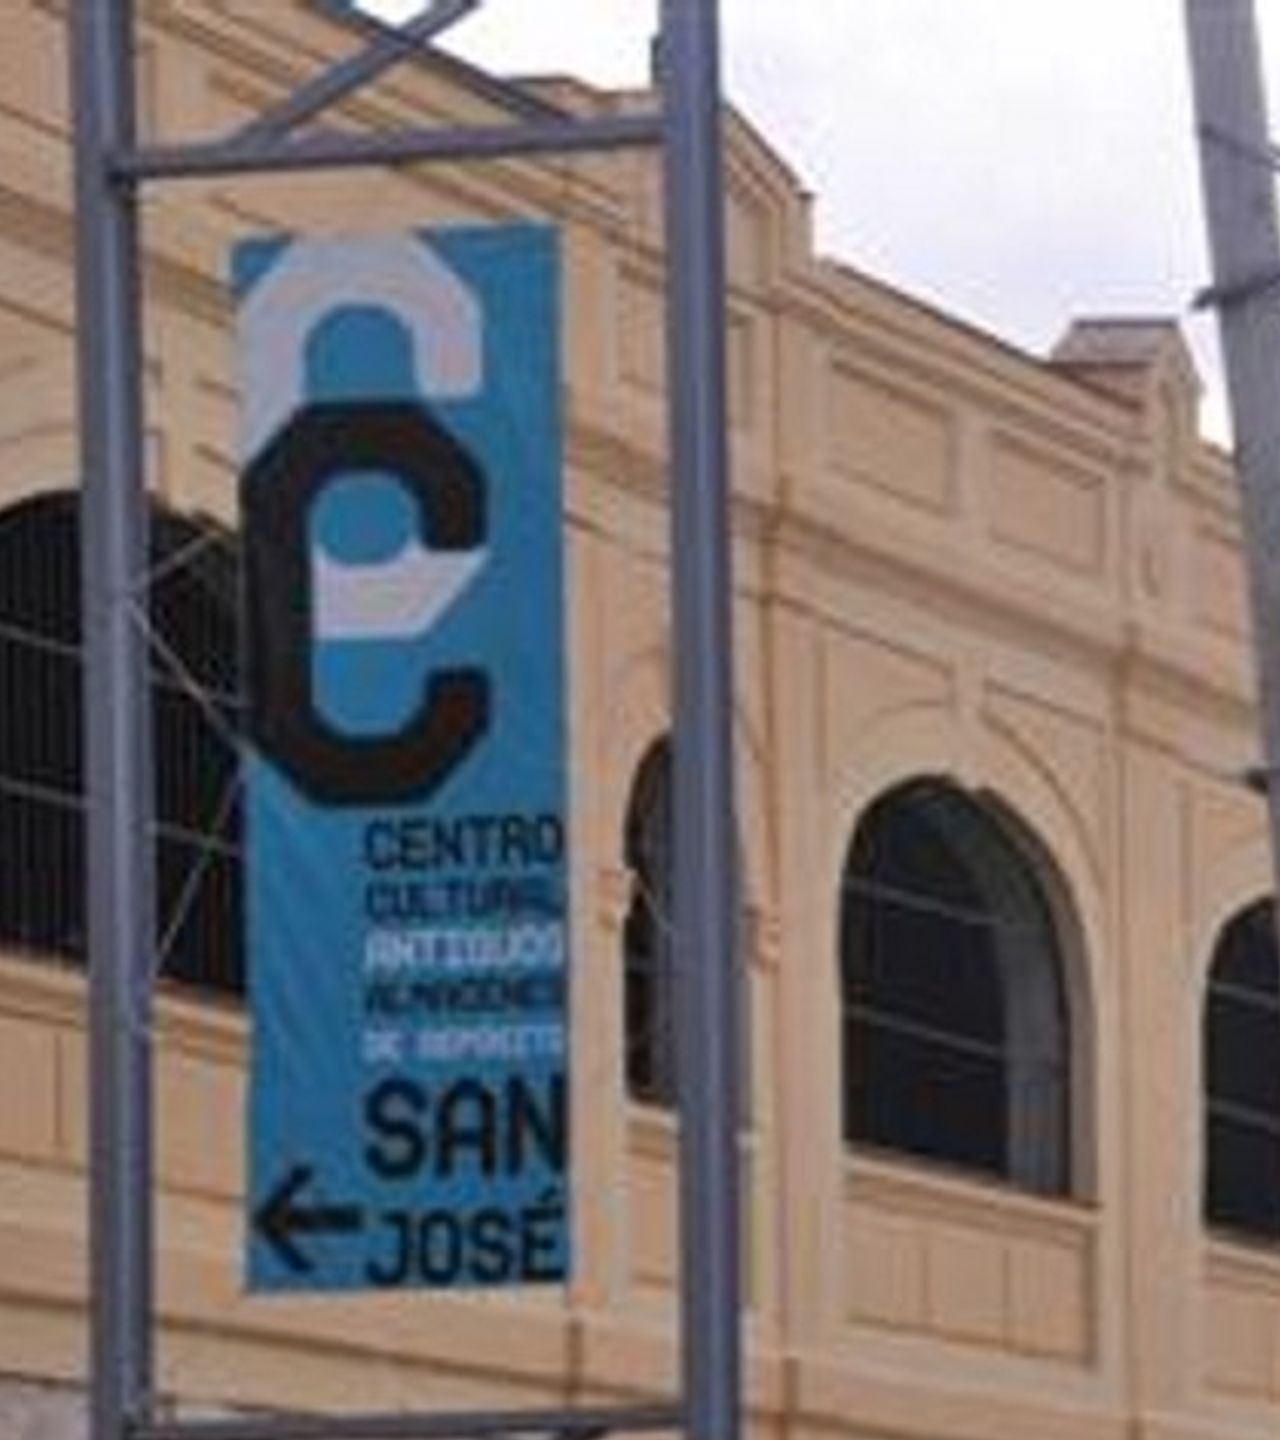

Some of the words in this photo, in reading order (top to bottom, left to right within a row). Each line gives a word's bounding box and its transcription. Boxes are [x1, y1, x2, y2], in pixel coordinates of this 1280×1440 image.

[365, 814, 564, 870] CENTRO
[364, 1072, 567, 1181] SAN
[364, 1188, 566, 1287] JOSÉ
